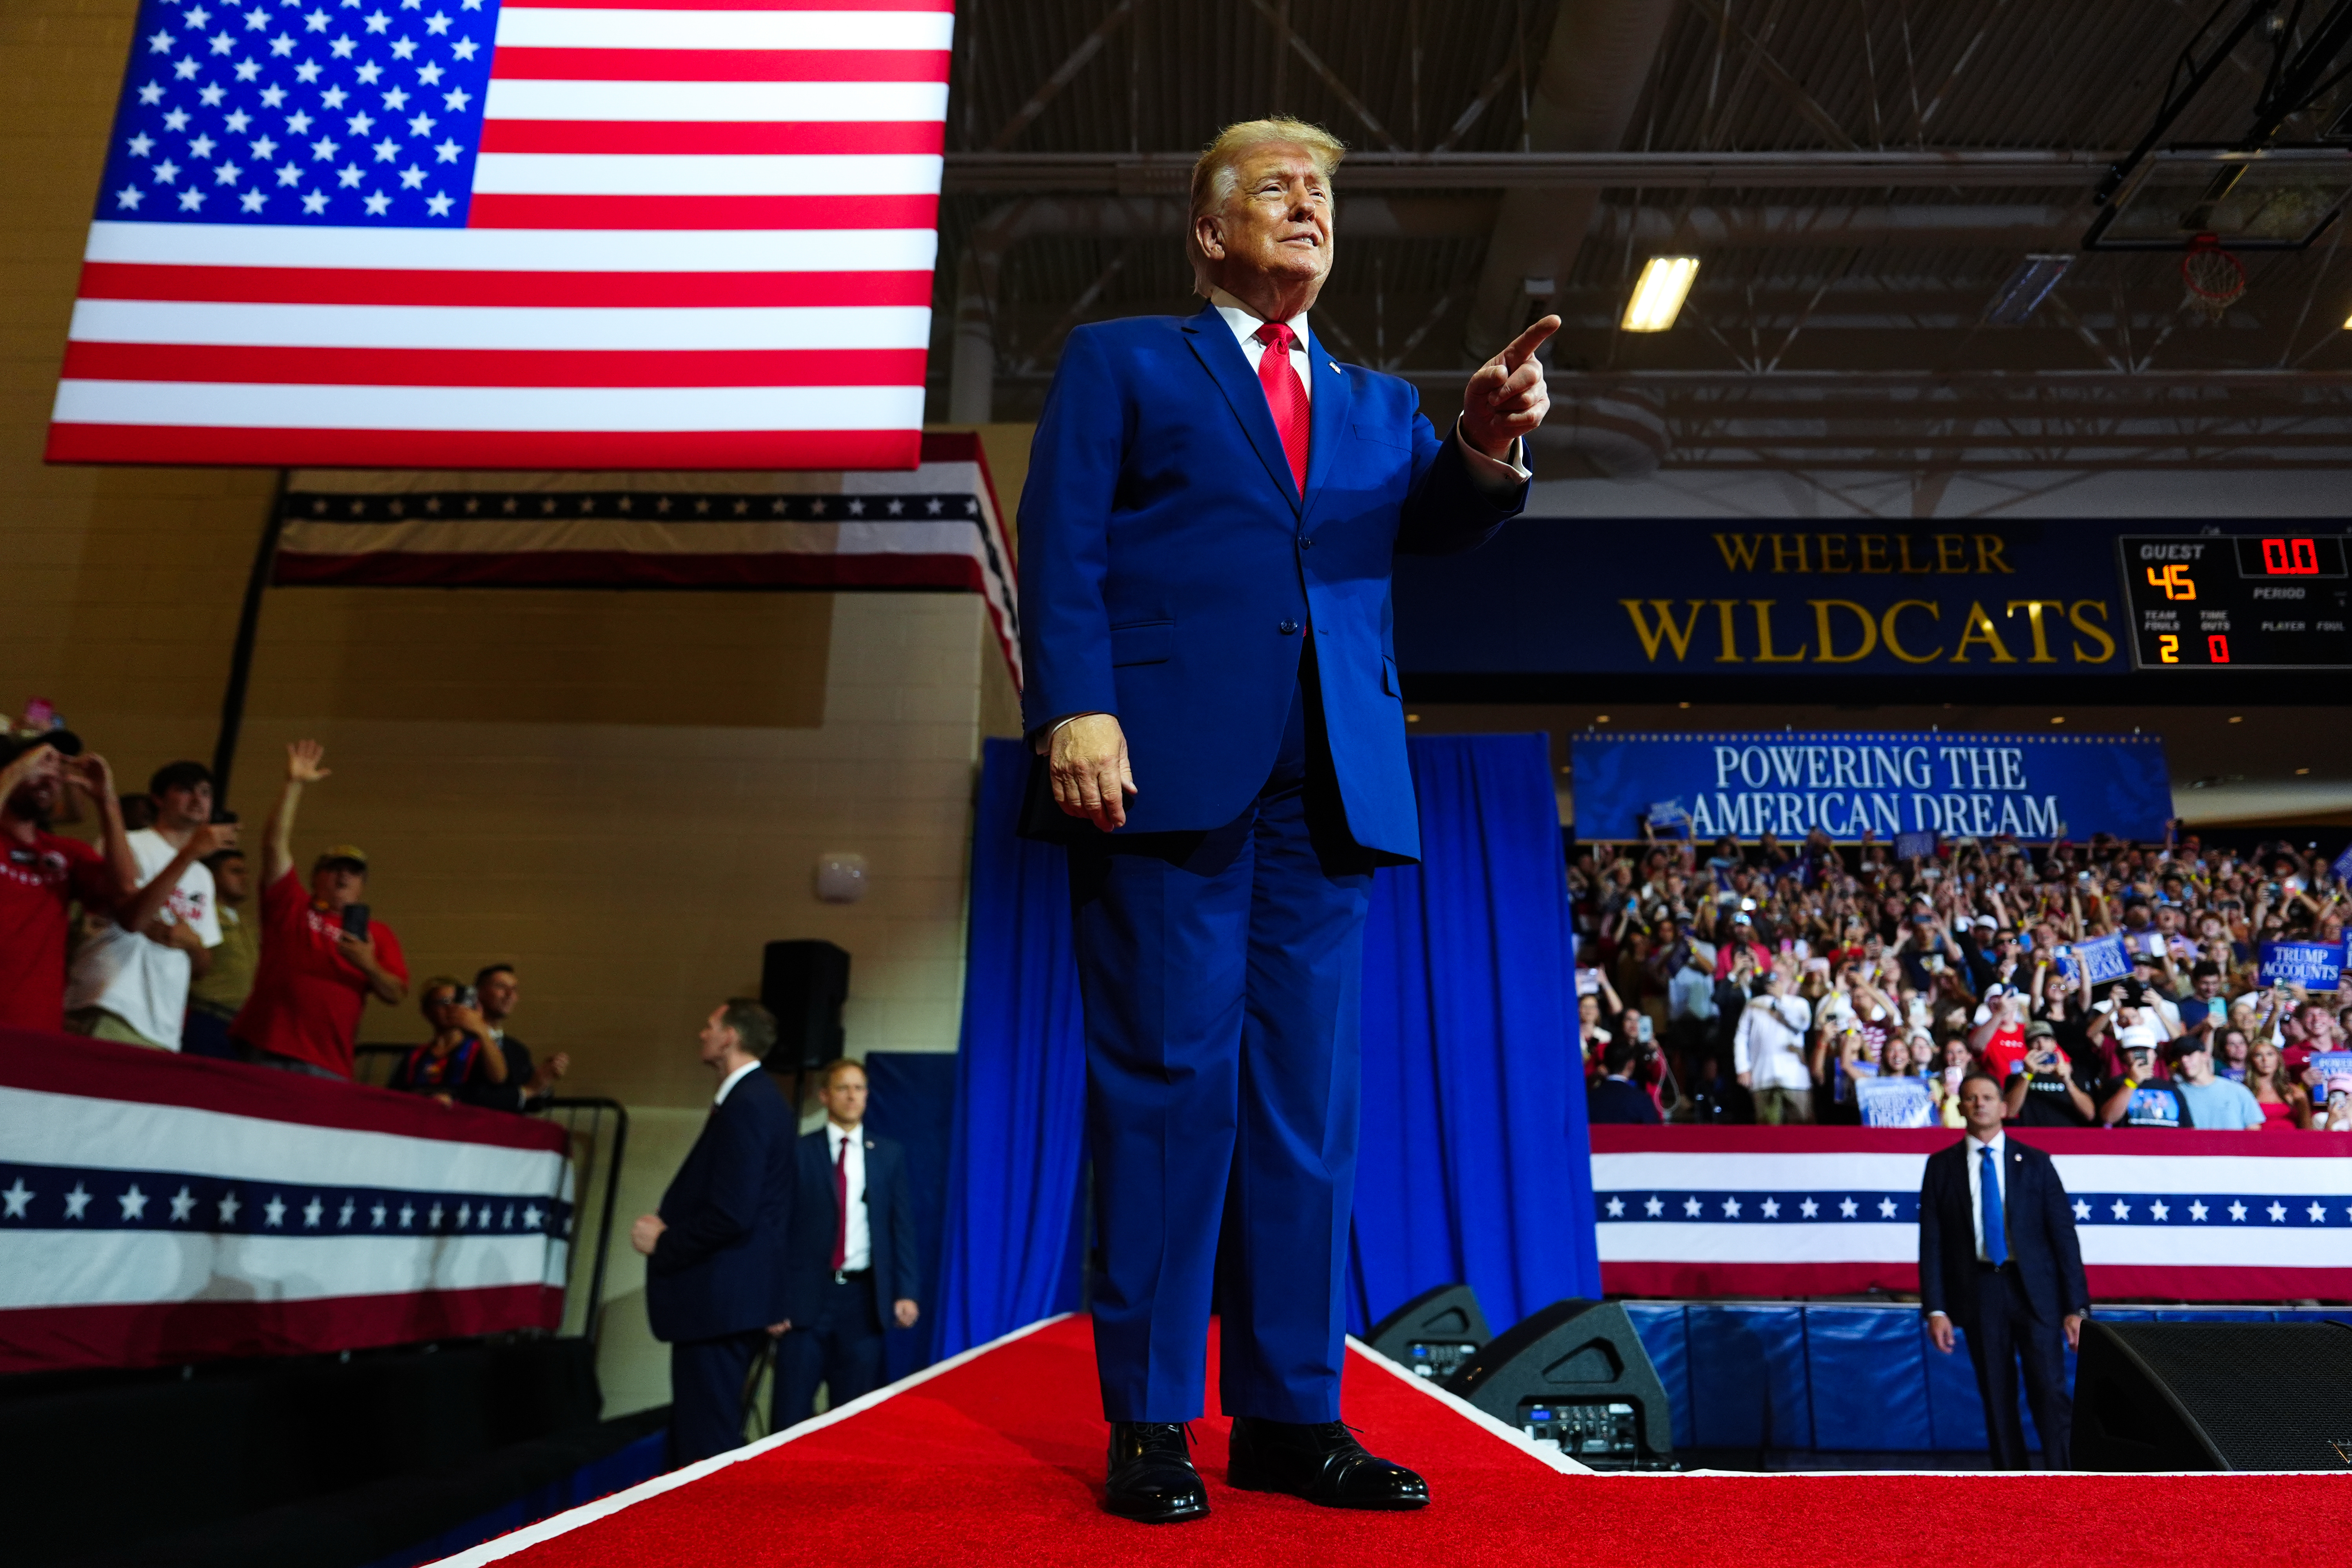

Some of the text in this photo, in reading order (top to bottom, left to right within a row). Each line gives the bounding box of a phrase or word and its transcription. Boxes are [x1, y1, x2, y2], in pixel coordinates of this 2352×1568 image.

[1713, 534, 2015, 573] WHEELER
[2140, 544, 2205, 561] GUEST
[2147, 564, 2196, 600] 45
[2253, 587, 2305, 599] PERIOD
[2144, 610, 2177, 619] TEAM
[2199, 610, 2229, 619] TIME
[2261, 621, 2306, 631] PLAYER
[1619, 600, 2116, 663] WILDCATS
[2159, 635, 2179, 662] 2
[2208, 635, 2230, 662] 0
[1713, 746, 2027, 790] POWERING THE
[1691, 792, 1900, 837] AMERICAN
[1911, 793, 2060, 837] DREAM
[2274, 946, 2328, 964] TRUMP
[2261, 961, 2339, 980] ACCOUNTS
